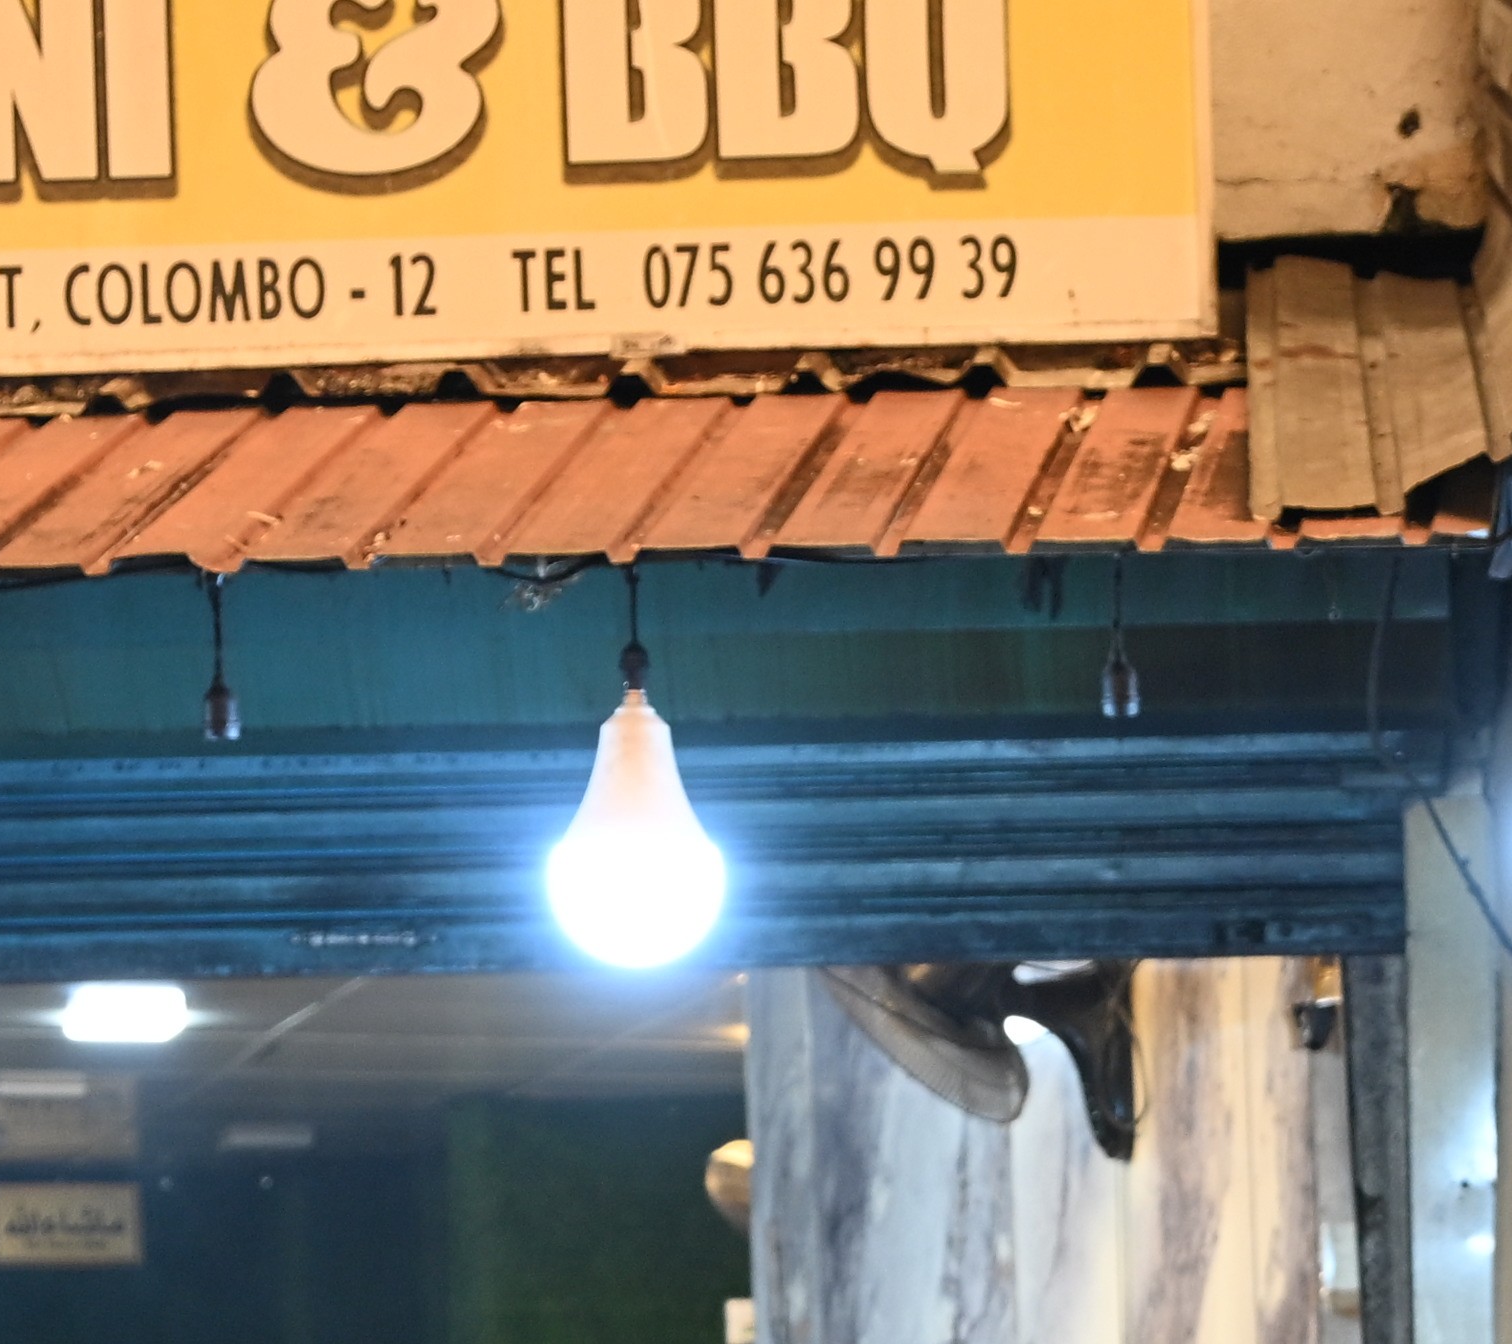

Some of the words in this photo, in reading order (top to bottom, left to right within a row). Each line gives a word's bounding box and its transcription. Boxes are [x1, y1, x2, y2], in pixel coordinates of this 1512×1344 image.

[248, 0, 503, 196] &
[560, 0, 1011, 190] BBQ
[64, 257, 326, 328] COLOMBO
[348, 288, 367, 299] -
[389, 255, 437, 317] 12
[512, 248, 596, 313] TEL
[643, 243, 733, 309] 075
[757, 239, 850, 305] 636
[872, 235, 935, 301] 99
[960, 233, 1018, 300] 39
